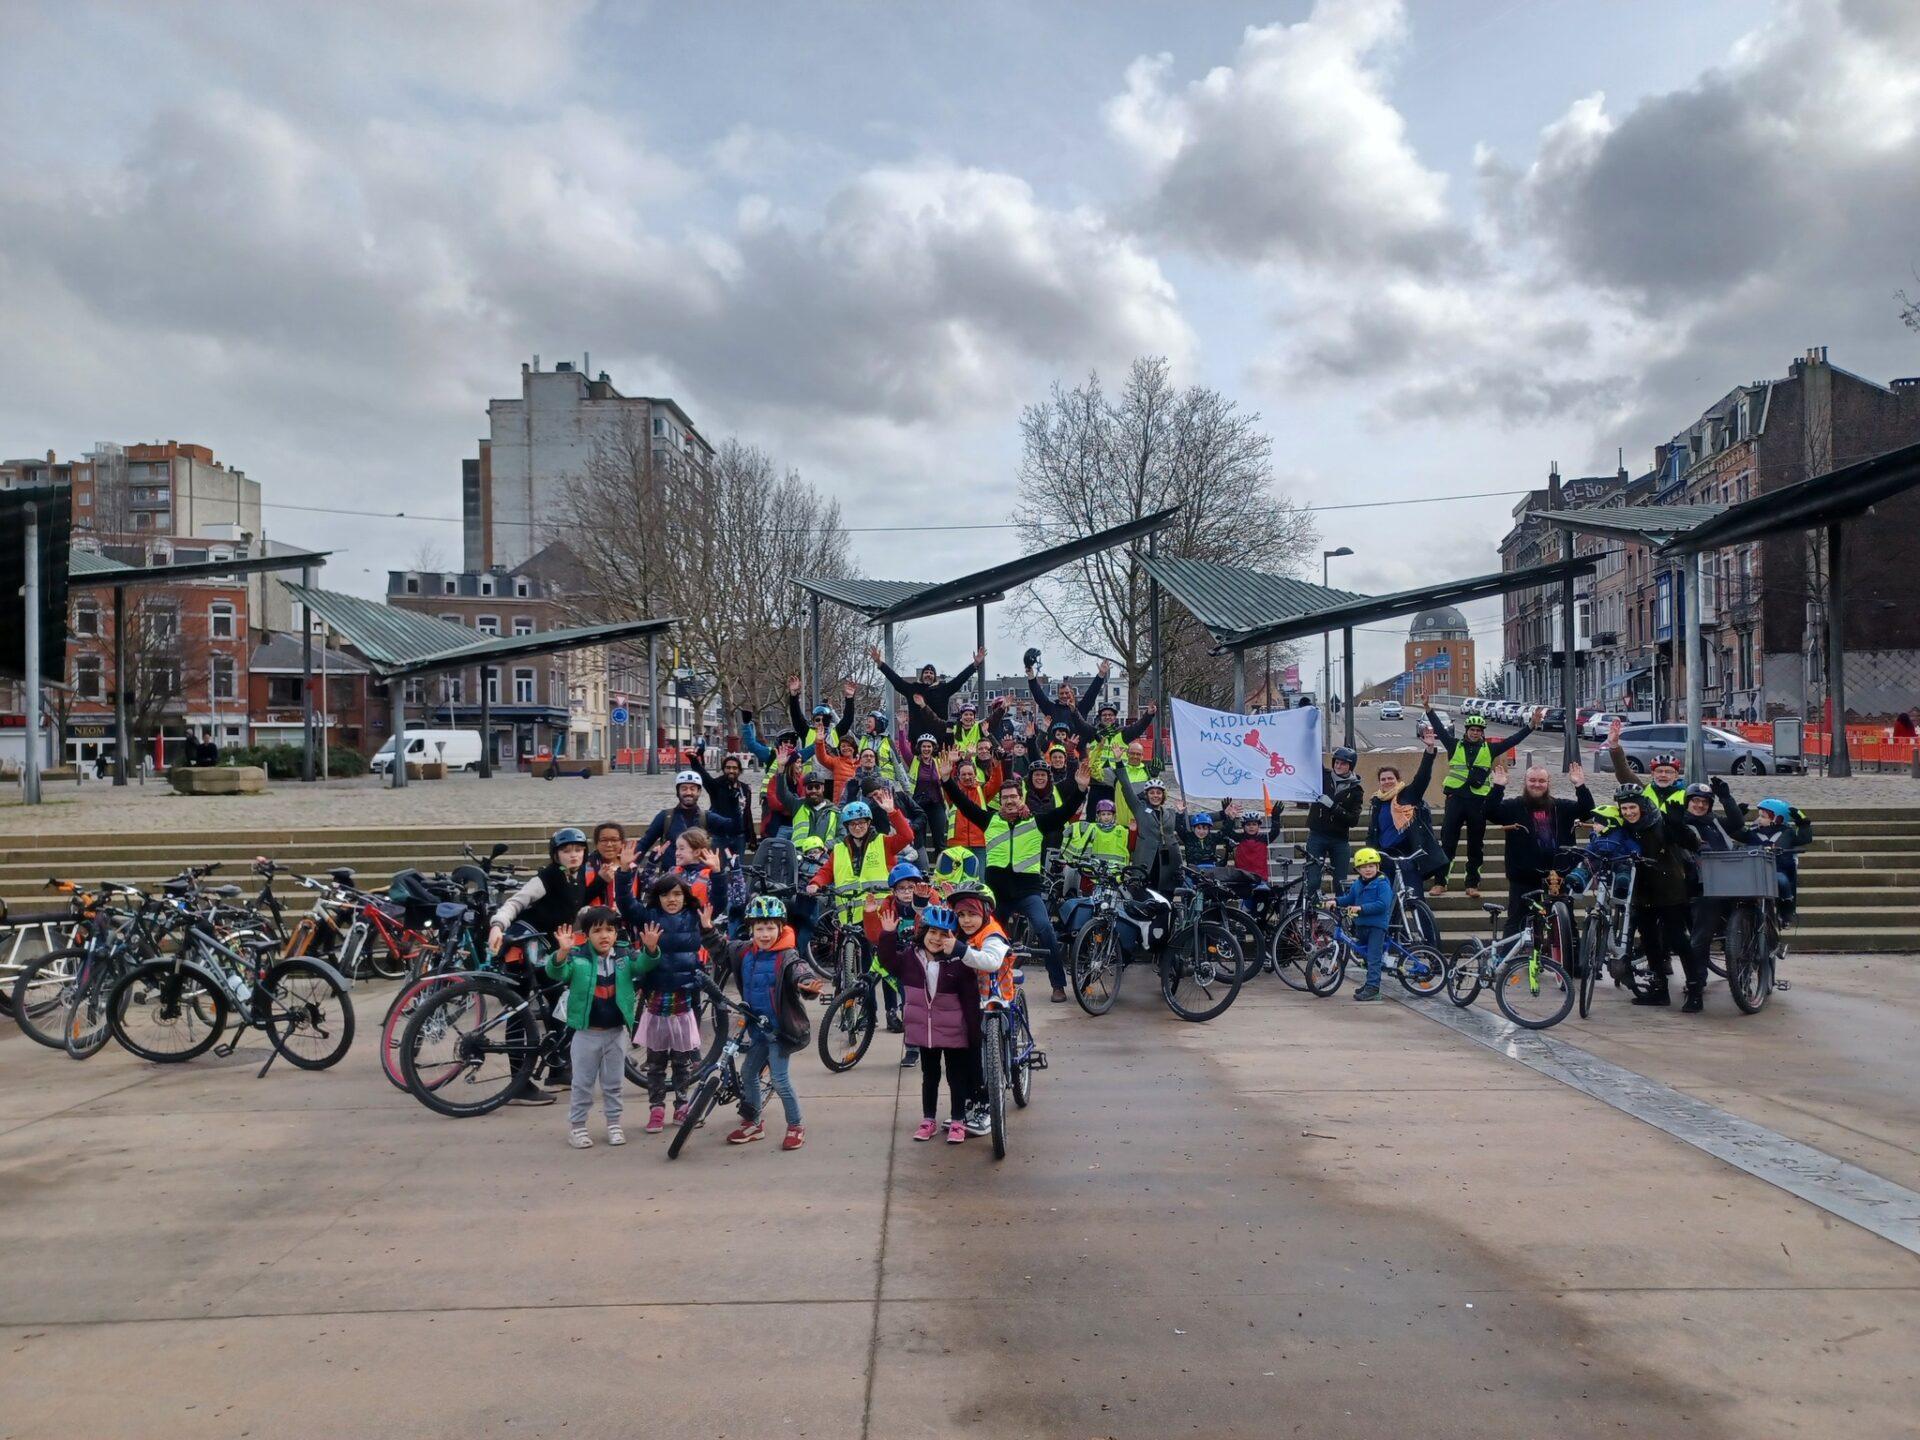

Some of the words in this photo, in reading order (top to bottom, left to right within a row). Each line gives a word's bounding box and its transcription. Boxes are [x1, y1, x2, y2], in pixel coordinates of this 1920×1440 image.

[1210, 714, 1277, 729] KIDICAL
[1200, 731, 1242, 747] MASS
[1202, 757, 1252, 785] Liège
